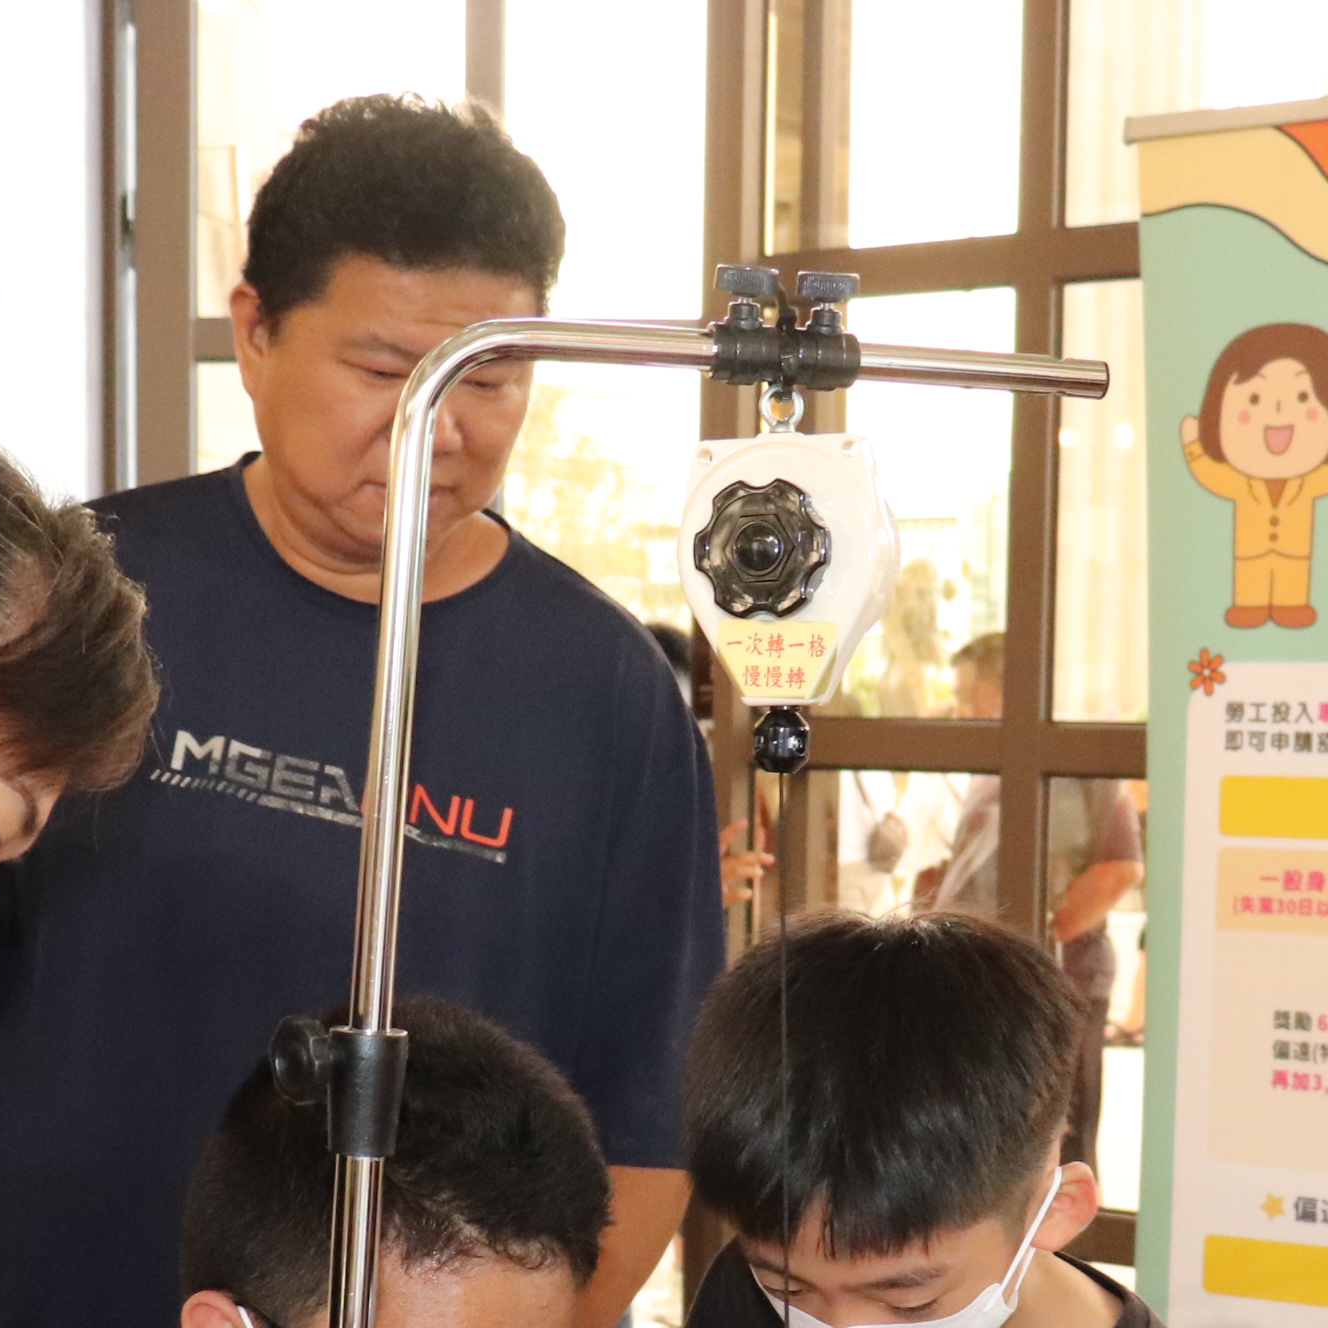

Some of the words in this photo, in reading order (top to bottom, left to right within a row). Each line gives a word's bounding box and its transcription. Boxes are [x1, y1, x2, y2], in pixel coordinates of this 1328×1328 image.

[727, 631, 828, 659] 一次轉一格
[742, 665, 807, 690] 慢慢轉
[171, 729, 514, 848] MGEANU
